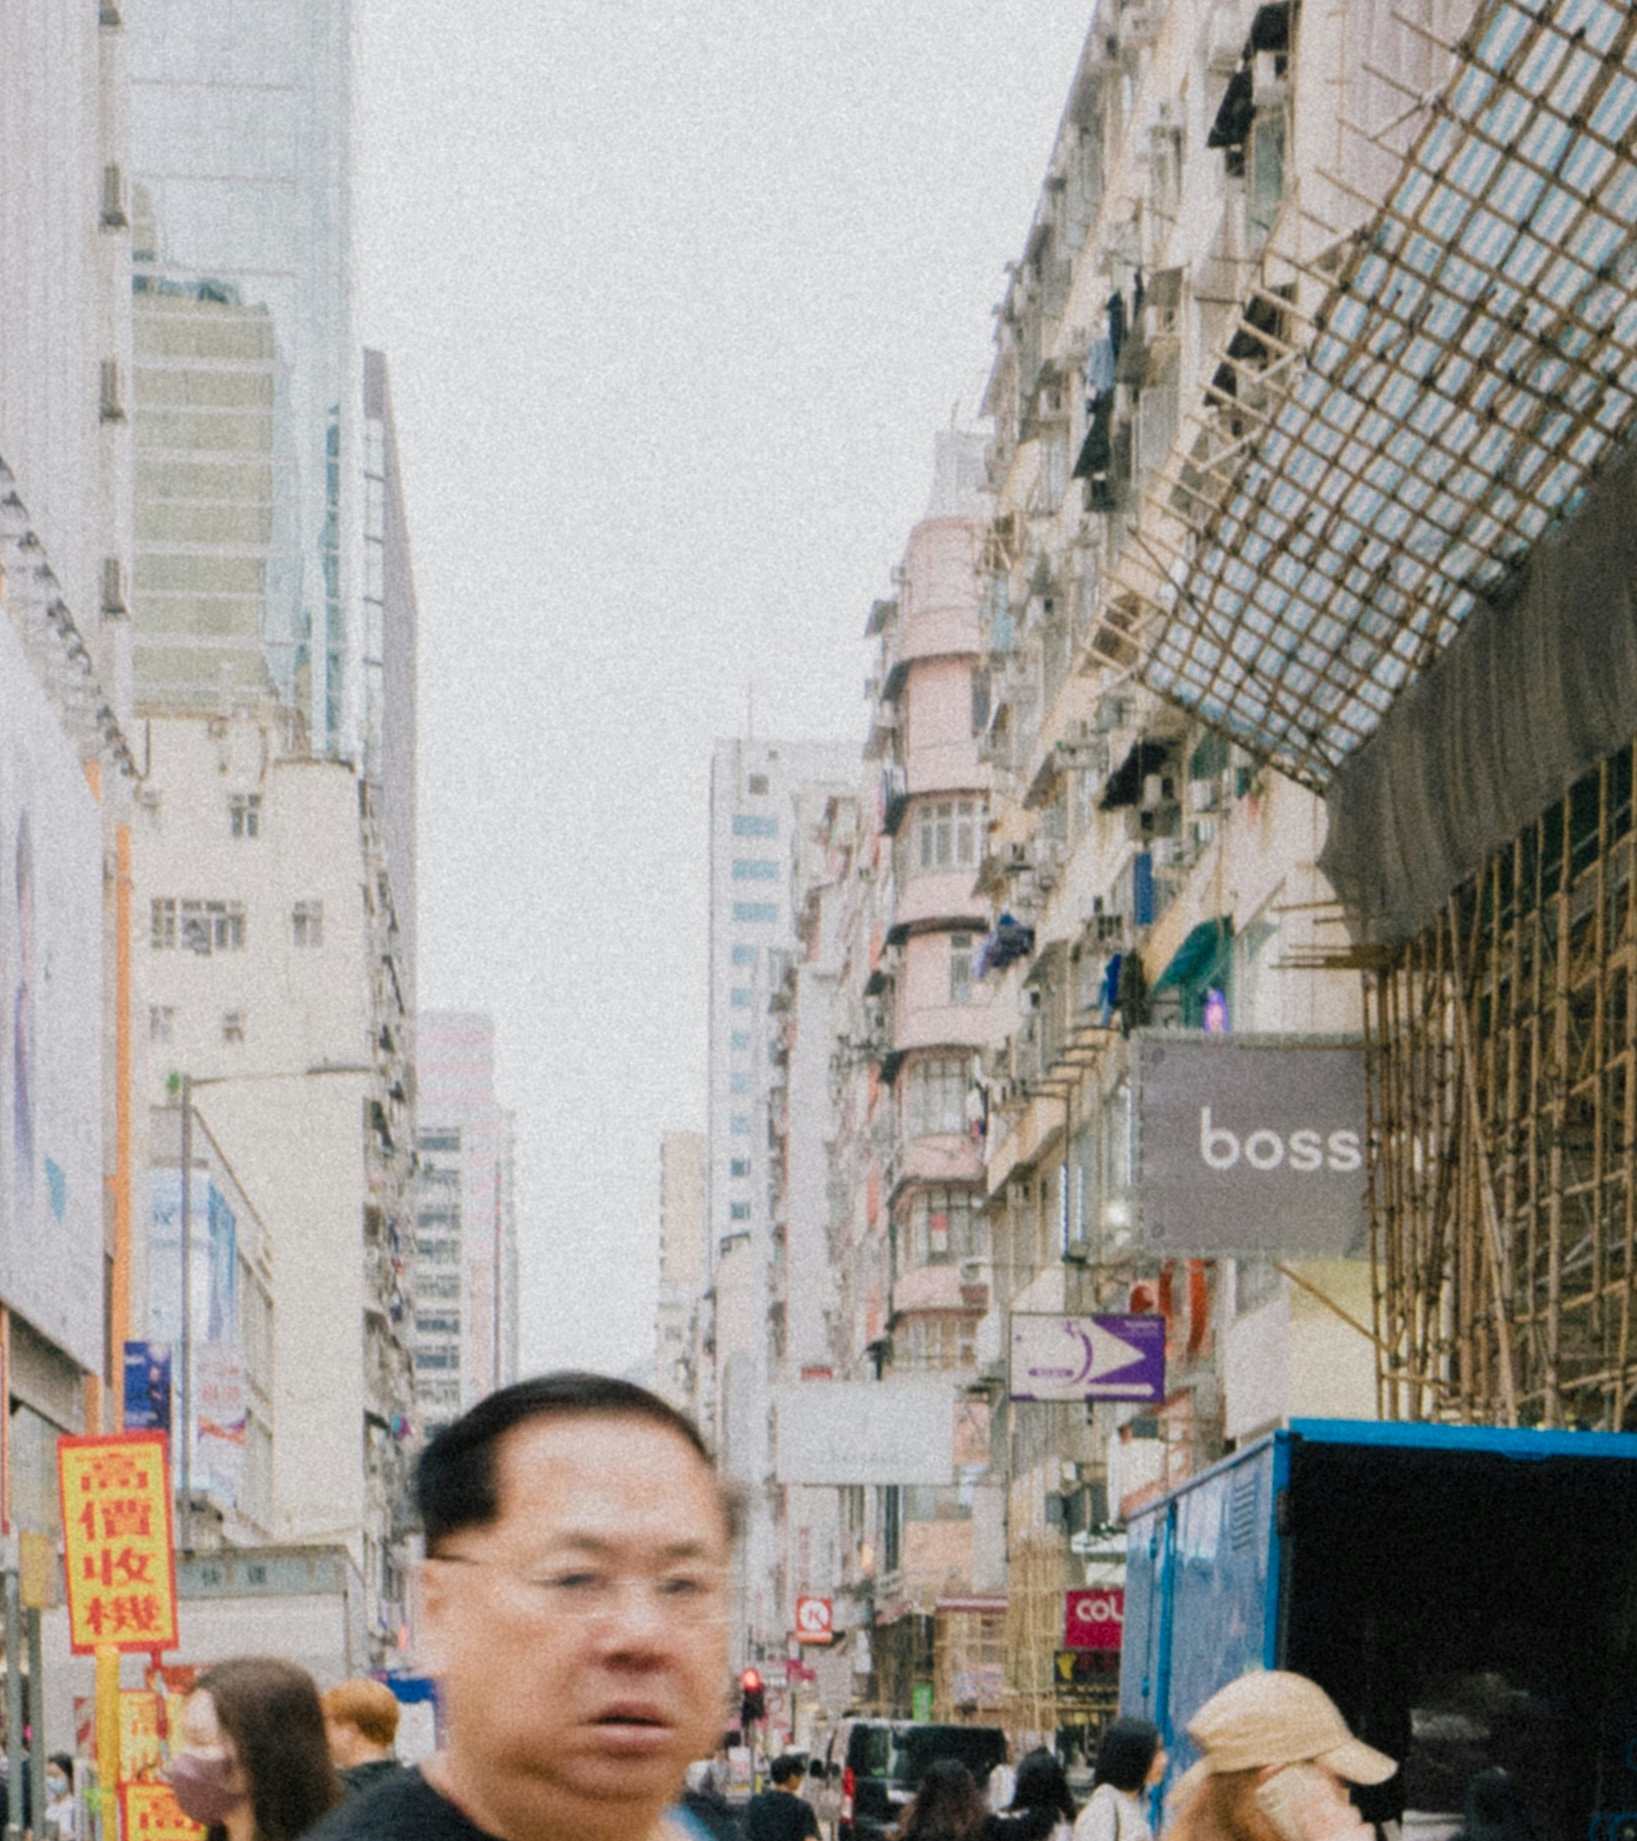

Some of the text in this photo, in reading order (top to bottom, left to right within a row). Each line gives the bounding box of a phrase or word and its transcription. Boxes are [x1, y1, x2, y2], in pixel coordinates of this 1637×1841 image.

[1201, 1106, 1362, 1171] boss
[74, 1452, 163, 1637] 高價收機
